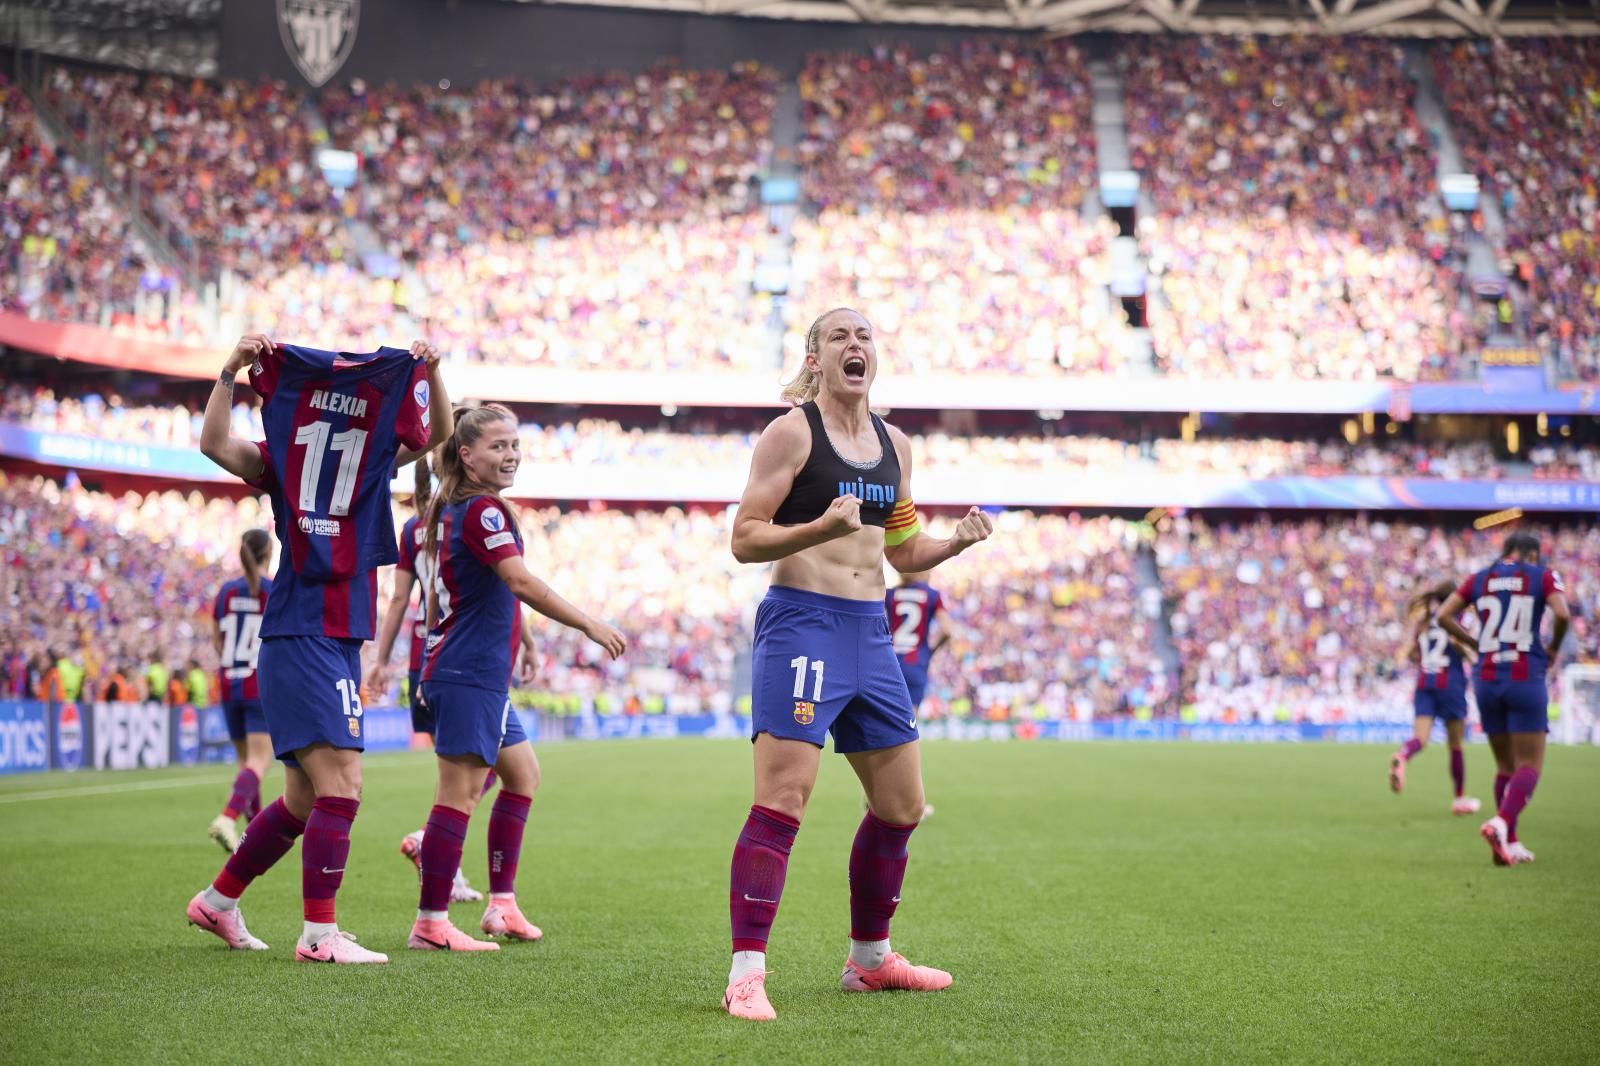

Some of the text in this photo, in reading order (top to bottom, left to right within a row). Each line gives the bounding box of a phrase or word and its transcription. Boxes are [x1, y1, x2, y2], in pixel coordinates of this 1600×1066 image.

[309, 390, 368, 418] ALEXIA
[294, 420, 369, 517] 11
[838, 476, 895, 509] wimu
[314, 518, 340, 528] UNHCR
[219, 612, 263, 669] 14
[893, 602, 922, 648] 2
[1476, 595, 1535, 653] 24
[1418, 627, 1451, 668] 12
[335, 678, 363, 717] 15
[790, 655, 825, 702] 11
[93, 701, 170, 771] PEPSI
